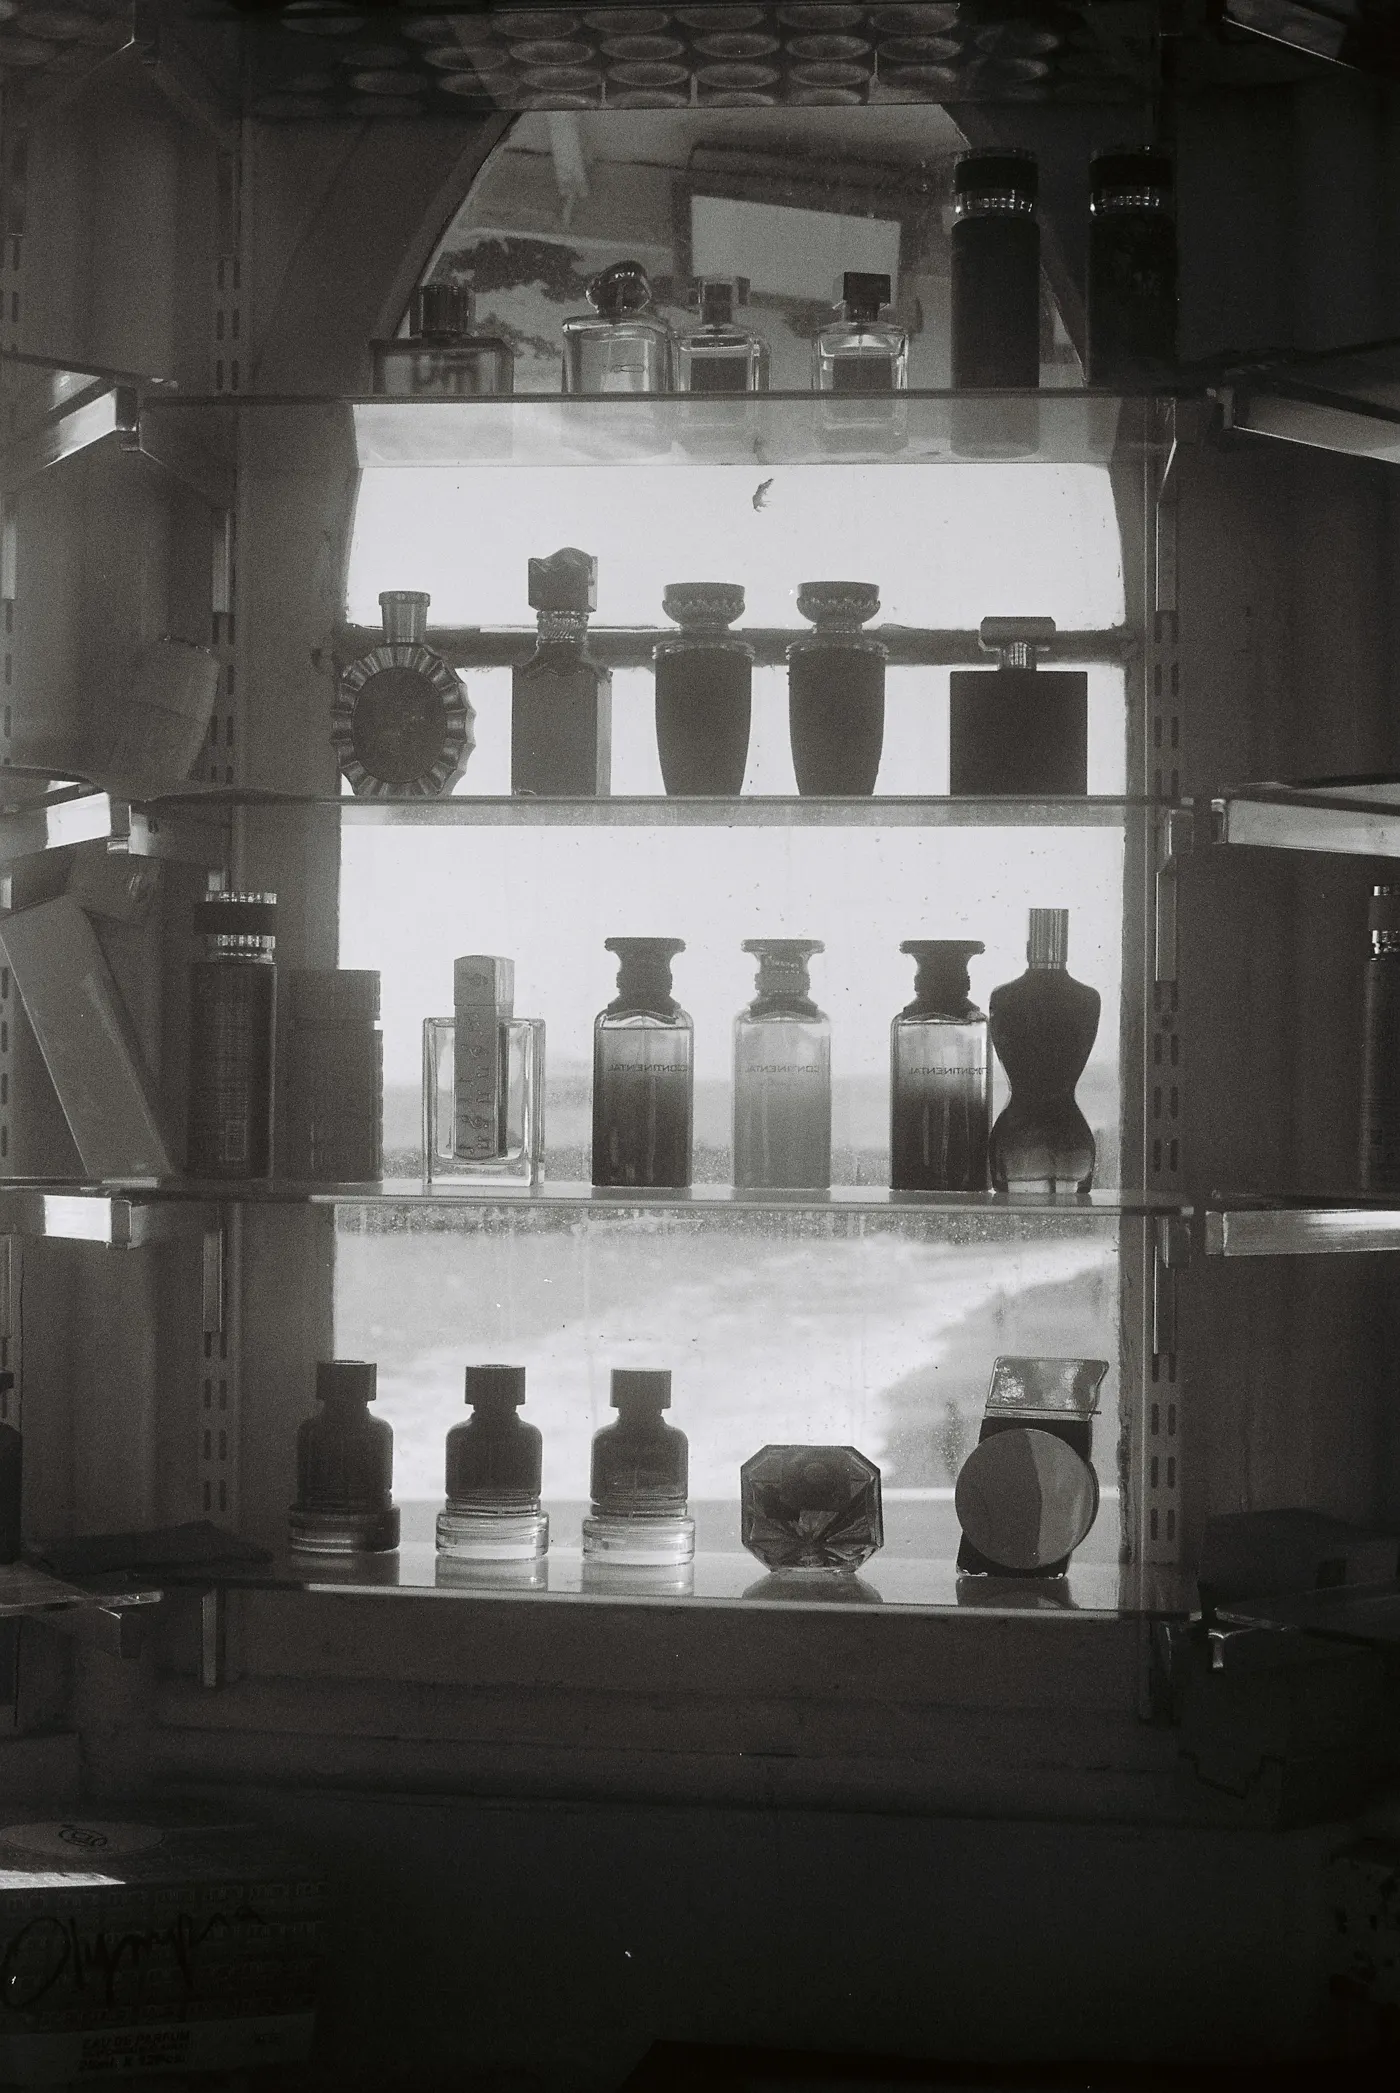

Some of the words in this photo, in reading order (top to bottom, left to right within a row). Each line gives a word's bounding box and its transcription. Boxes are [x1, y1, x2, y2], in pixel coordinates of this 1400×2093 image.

[83, 2038, 110, 2049] EAU
[114, 2036, 132, 2047] DE
[135, 2031, 190, 2046] PARFUM
